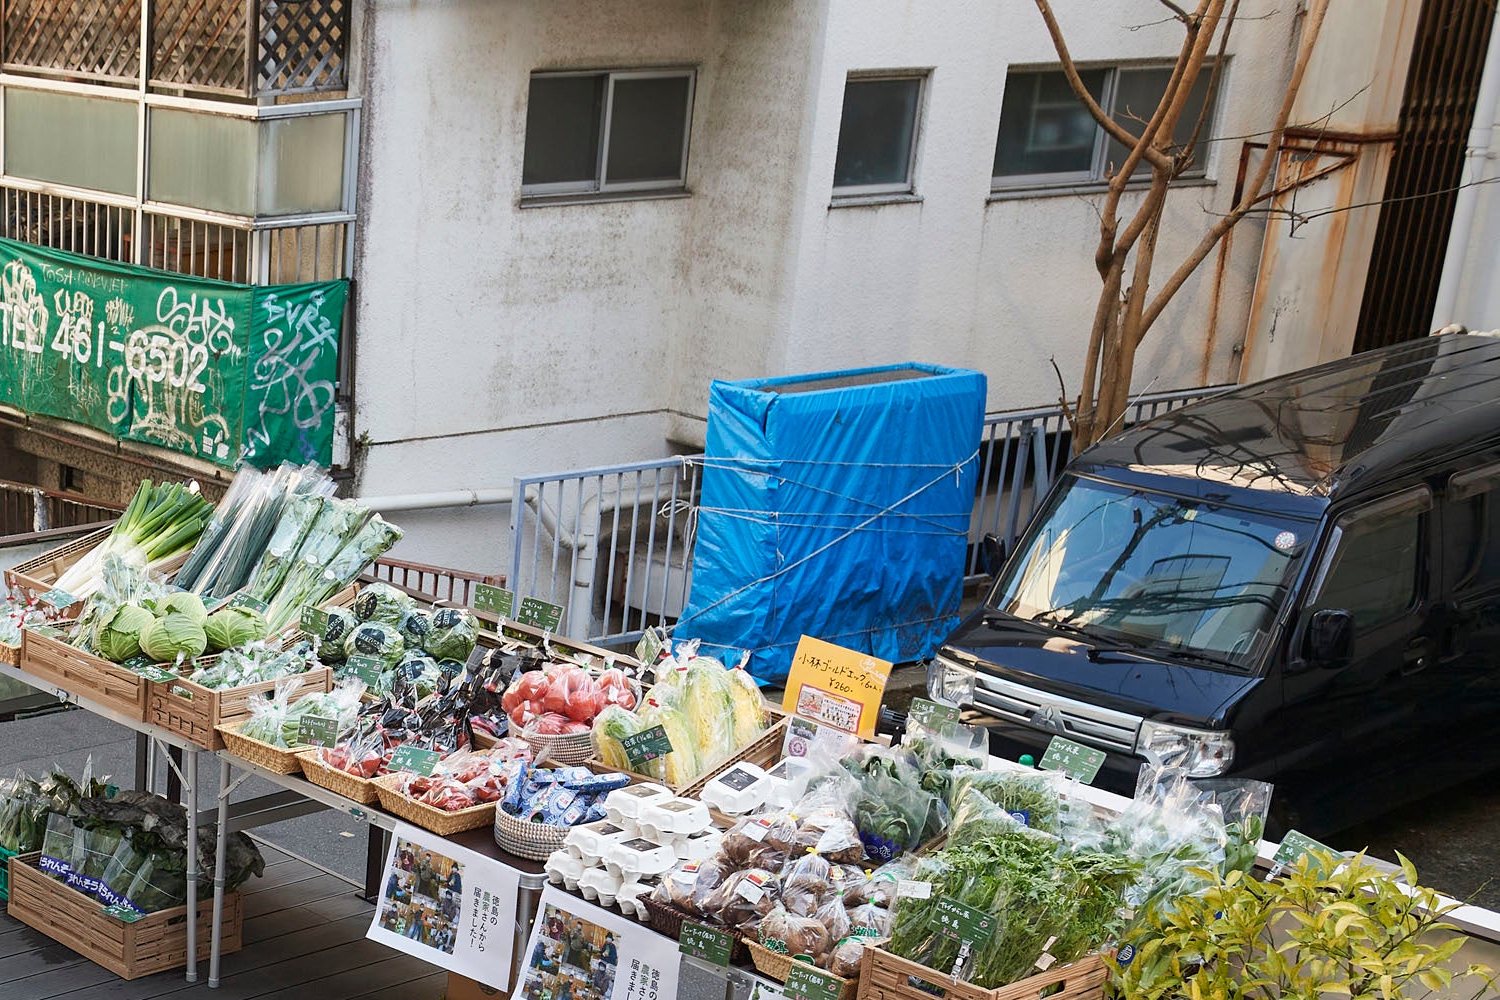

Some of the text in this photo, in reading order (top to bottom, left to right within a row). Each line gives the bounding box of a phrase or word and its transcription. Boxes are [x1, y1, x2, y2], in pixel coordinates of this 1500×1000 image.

[51, 312, 208, 393] 461-6502
[478, 891, 490, 952] 農家さんから
[489, 895, 500, 926] 徳島の
[648, 968, 660, 1000] 徳島の
